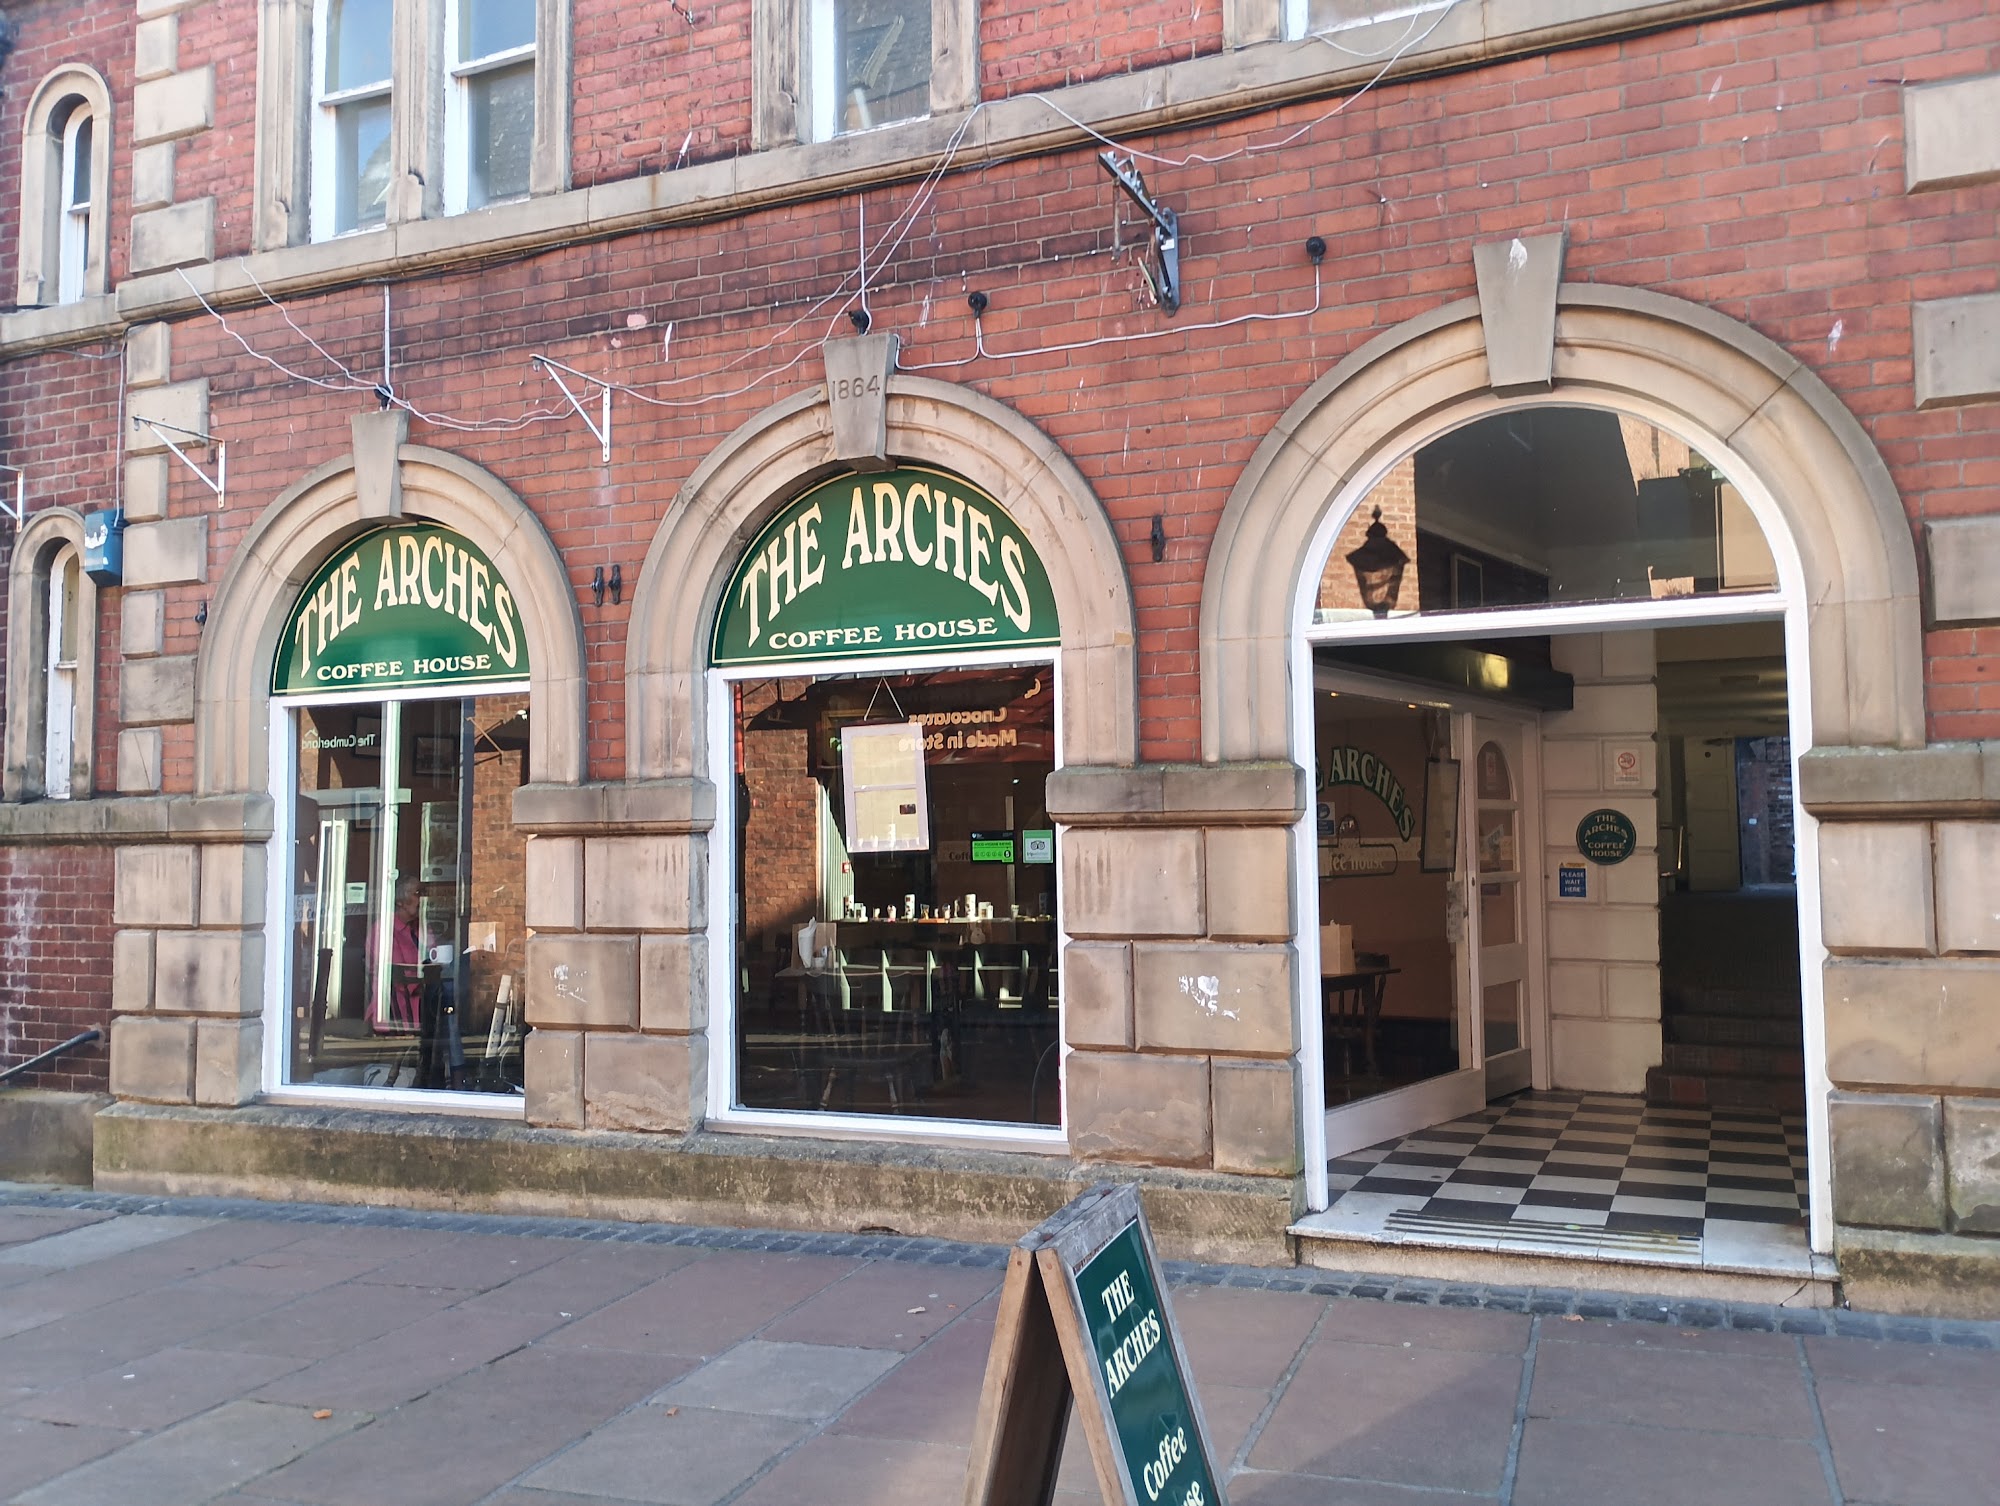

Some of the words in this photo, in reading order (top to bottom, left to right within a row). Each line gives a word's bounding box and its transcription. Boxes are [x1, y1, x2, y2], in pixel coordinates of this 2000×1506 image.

[832, 374, 880, 402] 1864
[739, 502, 826, 648] THE
[841, 482, 1031, 633] ARCHES
[294, 552, 363, 679] THE
[373, 535, 518, 668] ARCHES
[768, 625, 883, 650] COFFEE
[894, 616, 998, 641] HOUSE
[316, 660, 405, 681] COFFEE
[413, 654, 492, 675] HOUSE
[1329, 747, 1415, 842] ARCHES
[1584, 823, 1628, 839] ARCHES
[1595, 814, 1617, 823] THE
[1587, 842, 1626, 850] COFFEE
[1101, 1269, 1135, 1325] THE
[1104, 1308, 1161, 1400] ARCHES
[1143, 1426, 1188, 1502] Coffee
